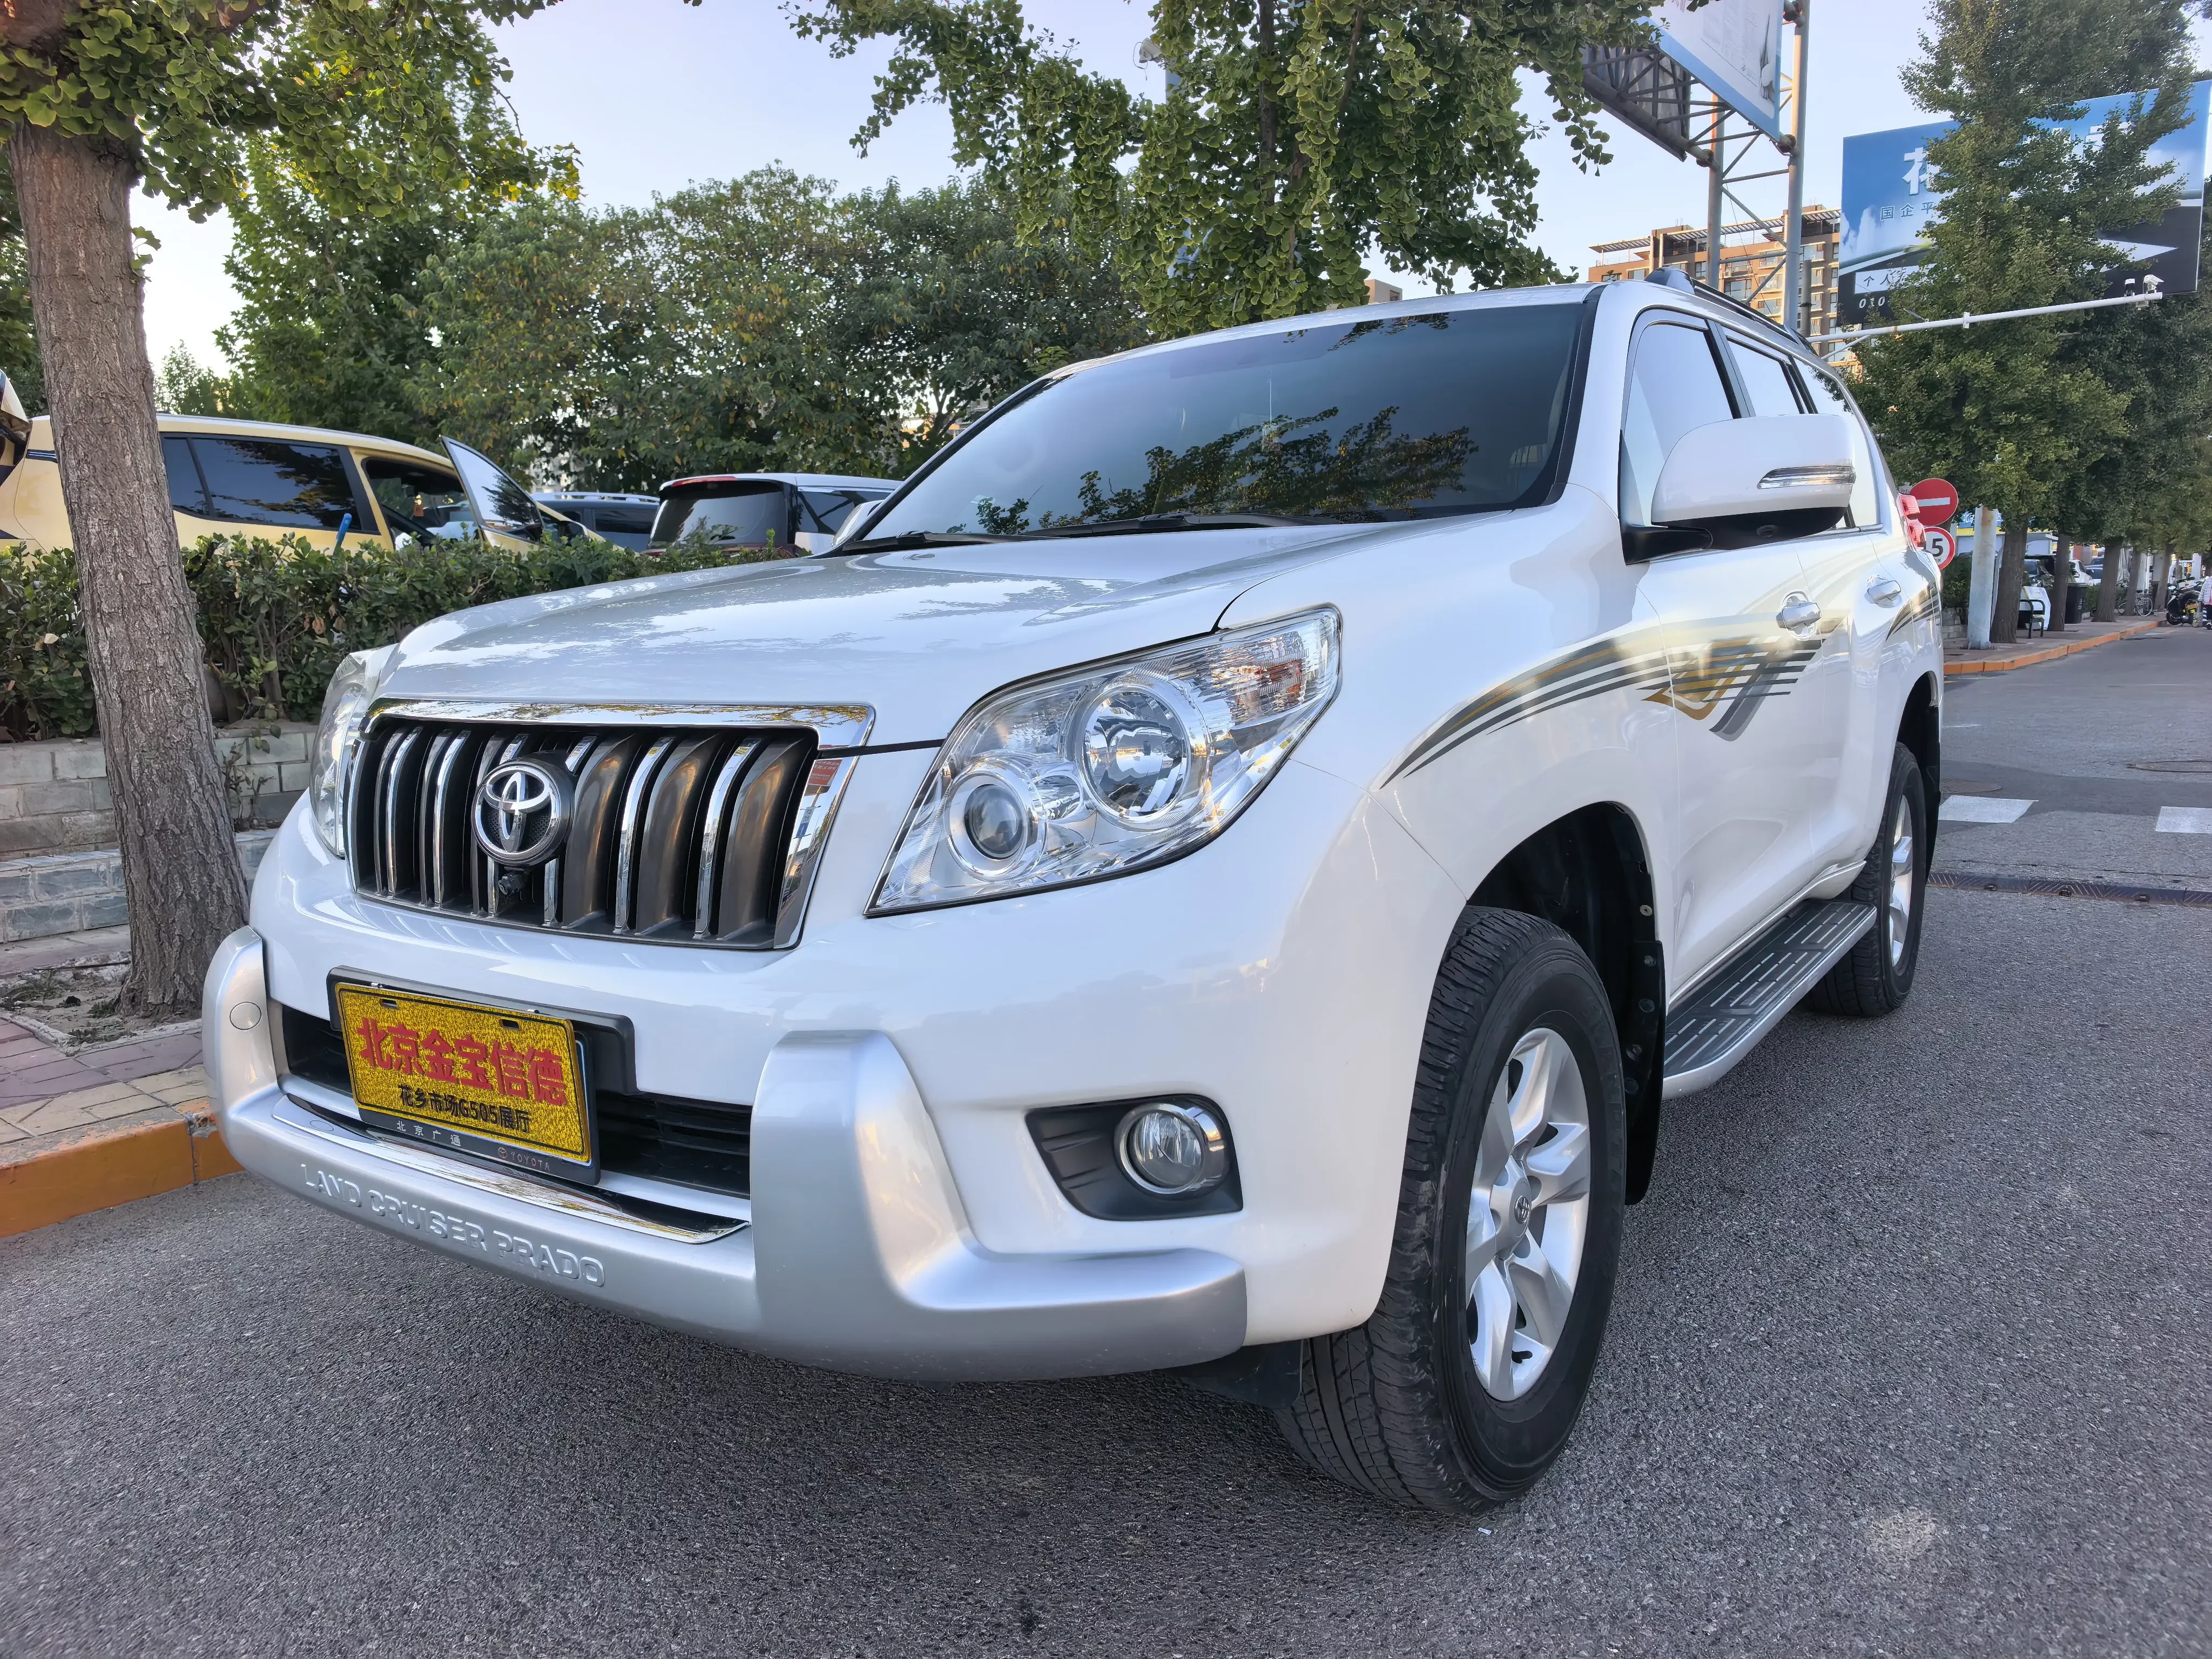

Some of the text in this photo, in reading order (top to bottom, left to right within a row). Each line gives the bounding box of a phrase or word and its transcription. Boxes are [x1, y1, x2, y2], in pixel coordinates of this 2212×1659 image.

[356, 1017, 568, 1105] 北京金宝信德
[396, 1120, 462, 1147] 北京广通
[397, 1083, 531, 1134] 花乡市场G505展厅
[510, 1150, 551, 1172] TOYOTA
[300, 1163, 605, 1287] LAND CRUISER PRADO
